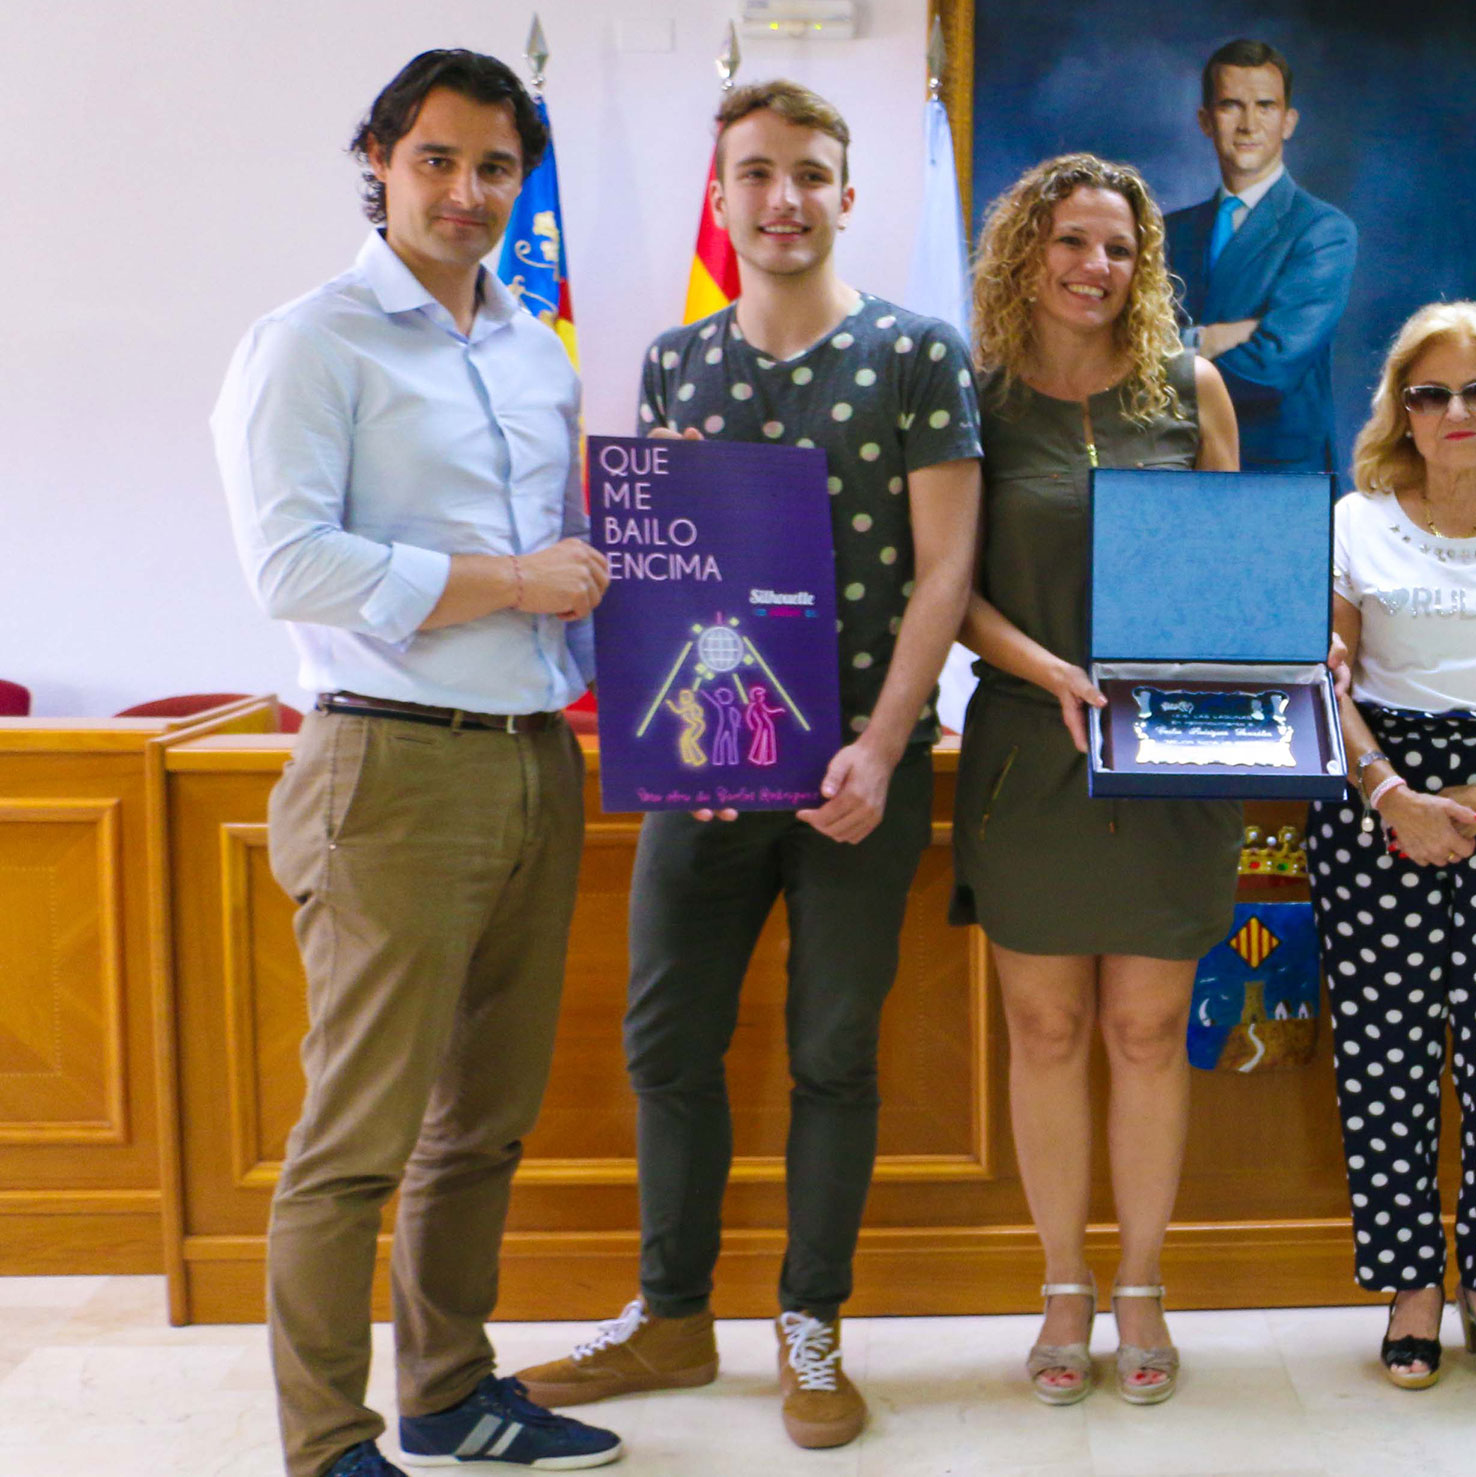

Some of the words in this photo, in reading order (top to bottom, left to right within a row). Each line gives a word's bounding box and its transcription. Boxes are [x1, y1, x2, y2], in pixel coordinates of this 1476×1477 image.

[600, 445, 669, 477] QUE
[603, 482, 652, 510] ME
[604, 516, 698, 547] BAILO
[606, 552, 723, 582] ENCIMA
